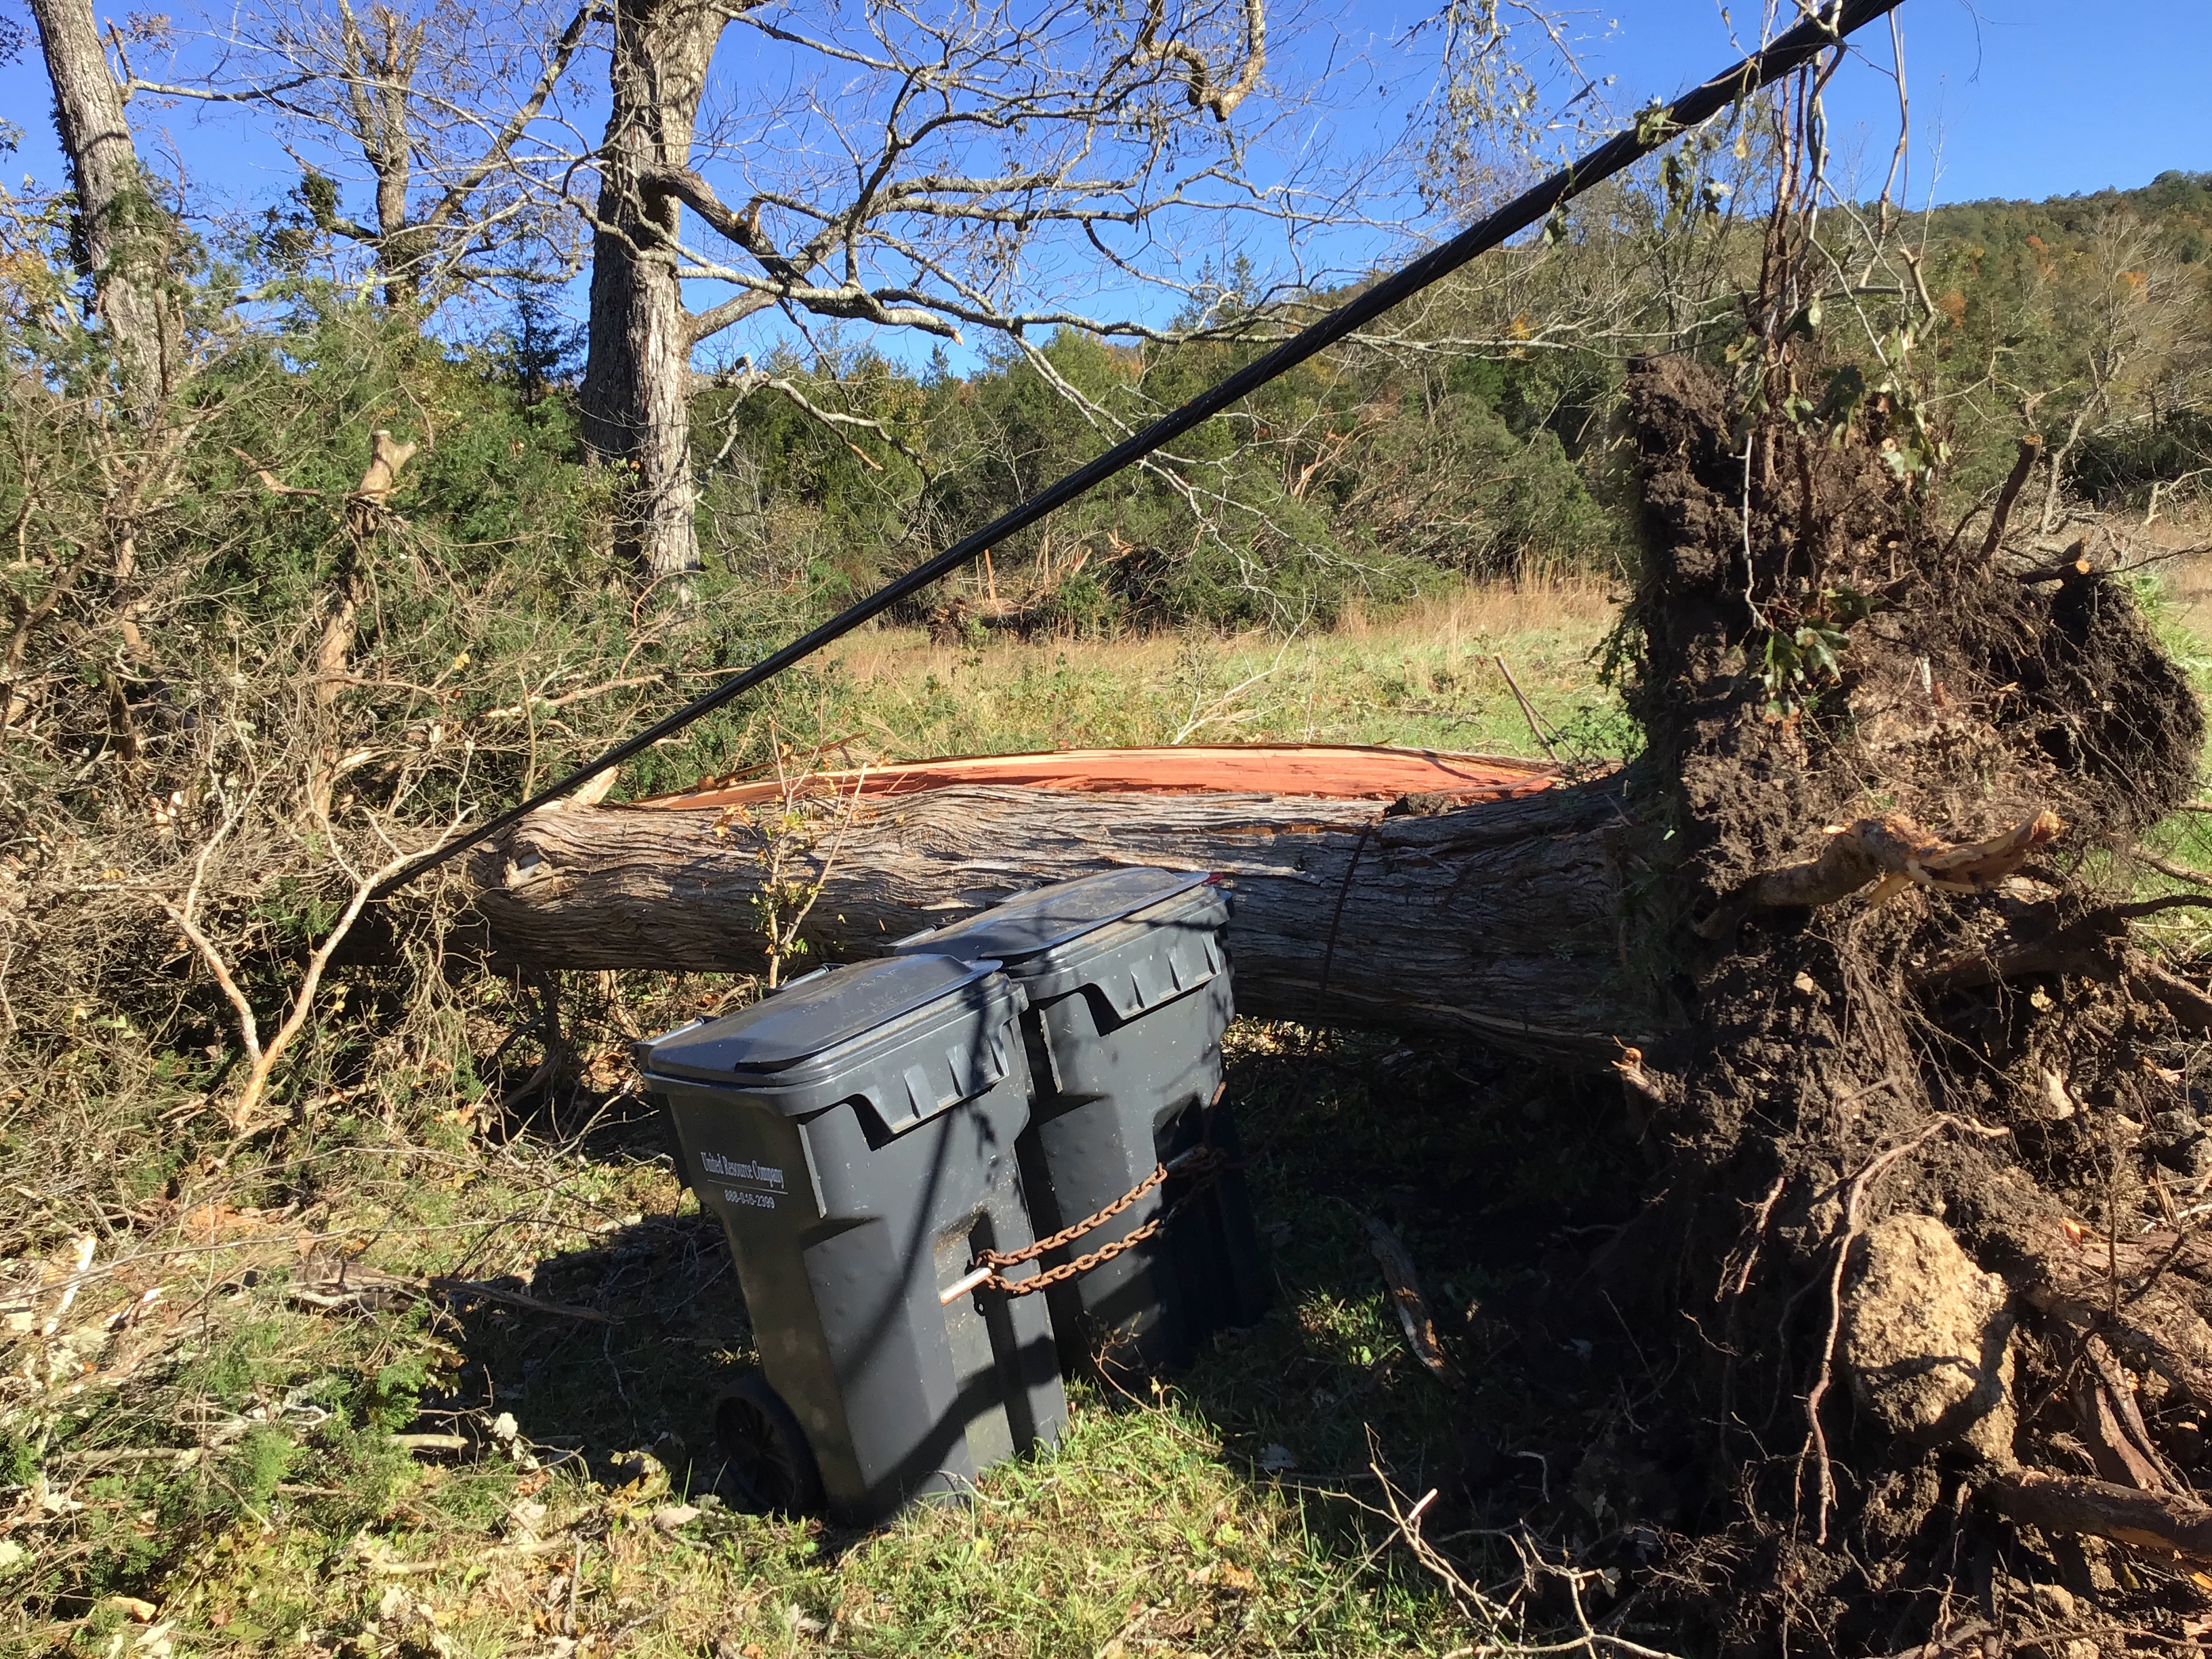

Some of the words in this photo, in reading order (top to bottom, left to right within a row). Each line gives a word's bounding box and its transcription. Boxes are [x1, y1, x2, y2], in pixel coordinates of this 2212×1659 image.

[701, 1152, 724, 1174] United
[722, 1155, 753, 1179] Resource
[752, 1160, 784, 1189] Company
